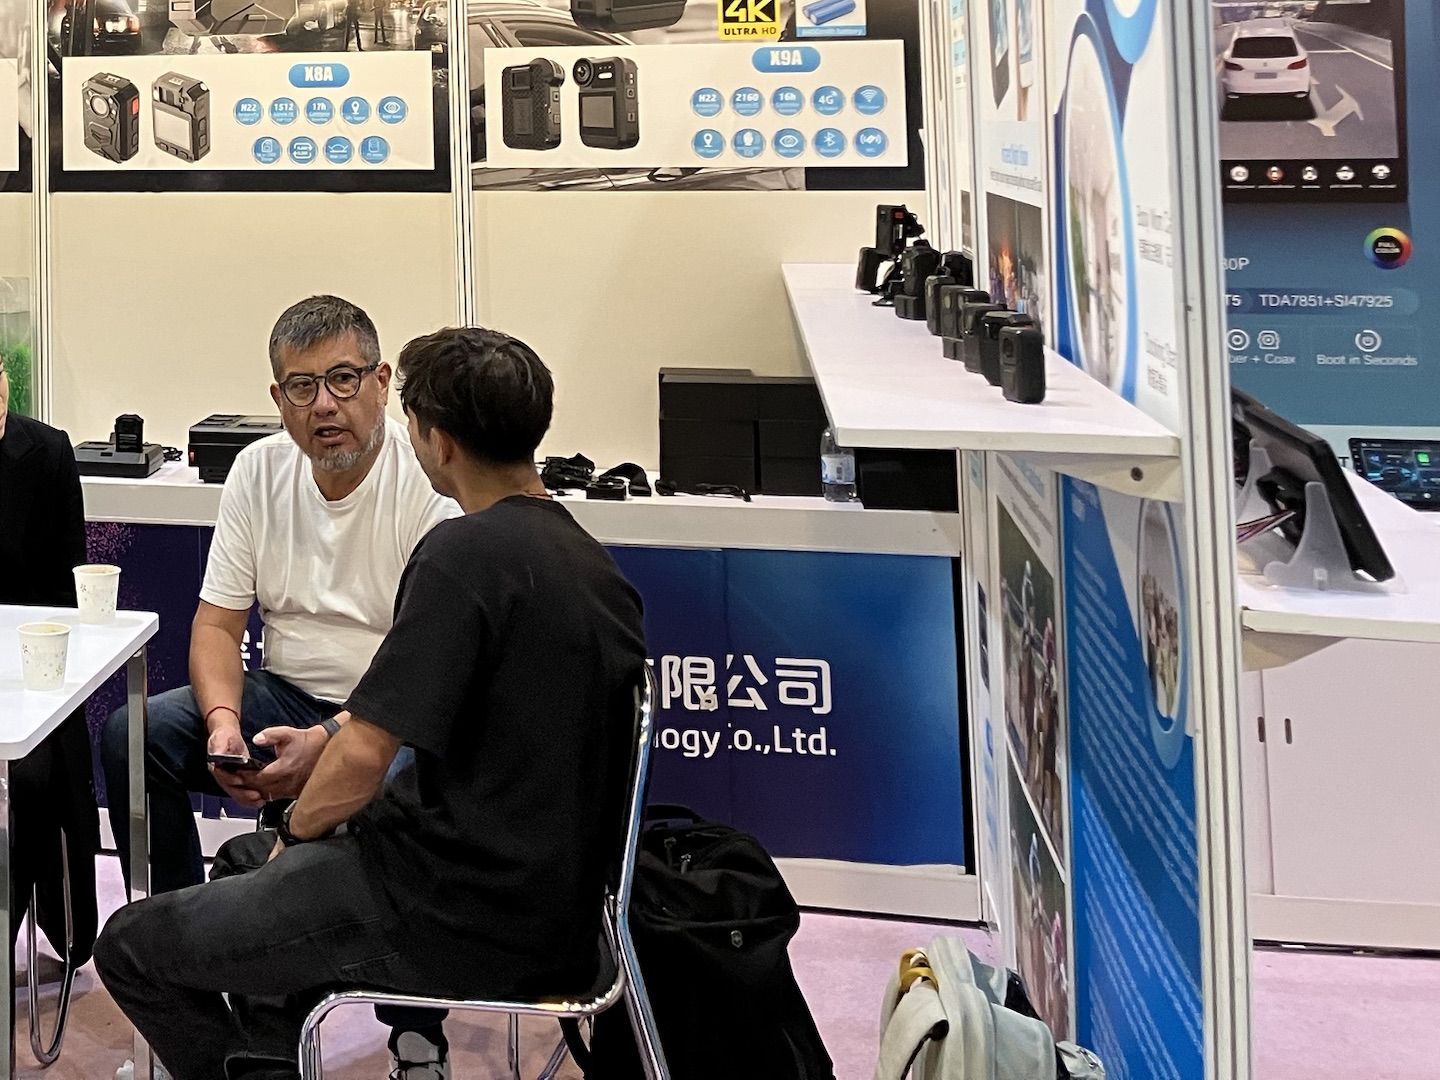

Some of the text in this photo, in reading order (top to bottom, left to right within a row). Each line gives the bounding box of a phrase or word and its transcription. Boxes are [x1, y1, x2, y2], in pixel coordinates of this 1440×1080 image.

[724, 27, 777, 36] ULTRA HD
[645, 654, 832, 714] 限公司
[727, 723, 837, 756] o.,Ltd.
